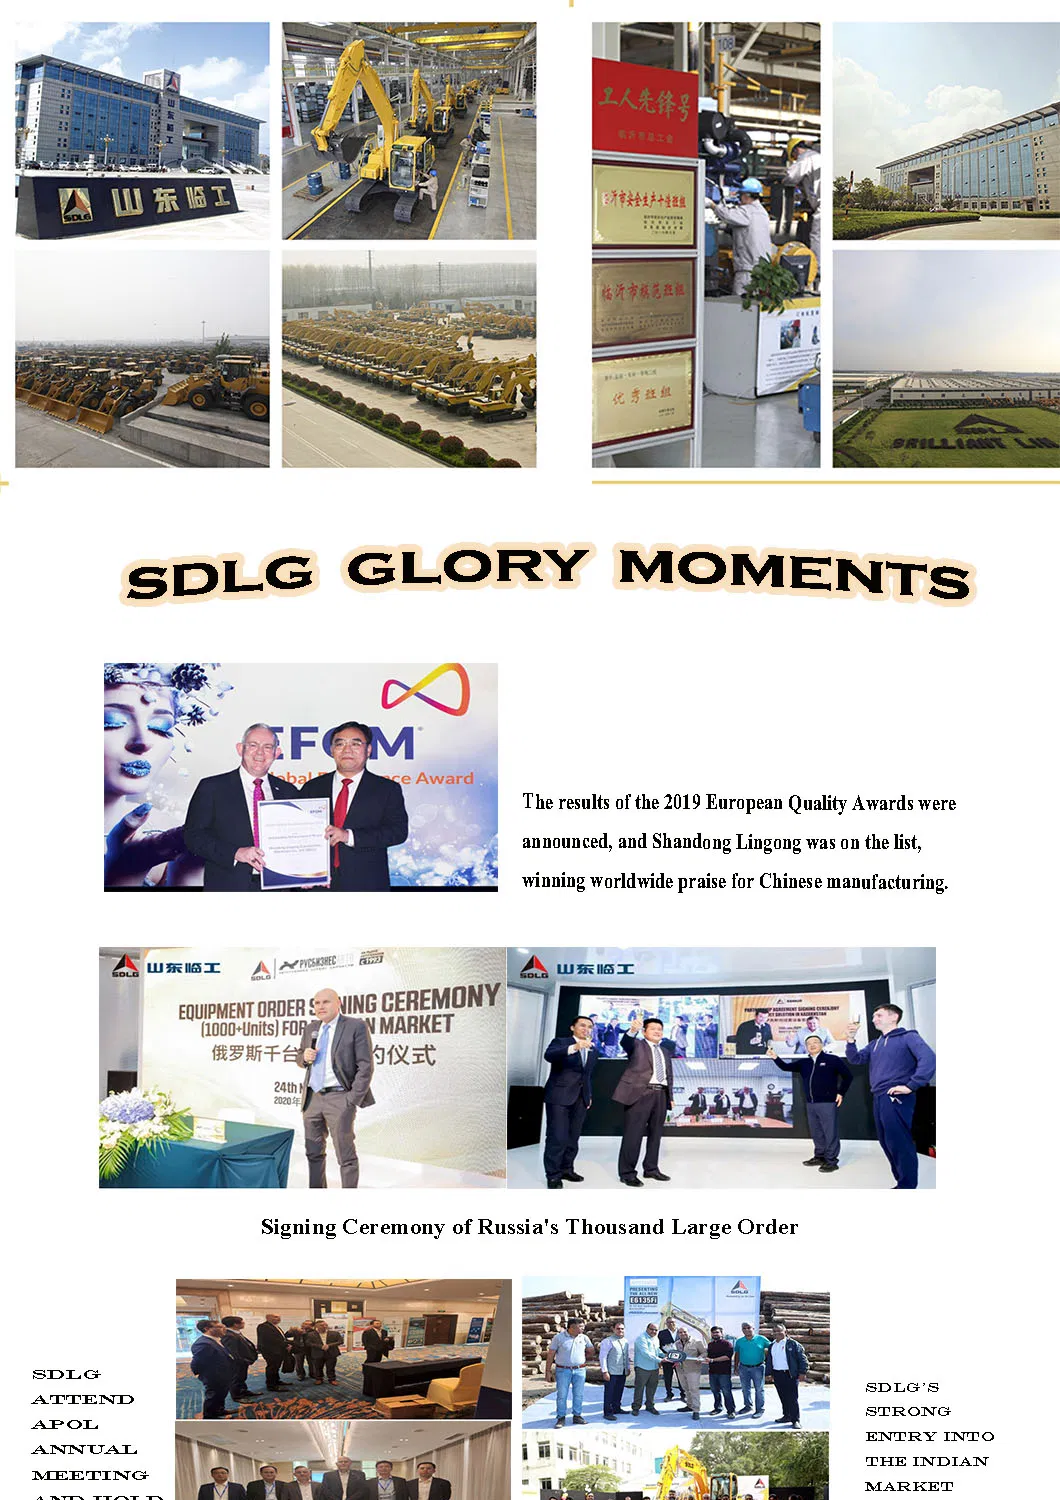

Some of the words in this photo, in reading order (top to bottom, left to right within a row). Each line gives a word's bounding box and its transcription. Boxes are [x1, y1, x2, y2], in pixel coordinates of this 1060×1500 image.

[717, 36, 735, 50] 108
[598, 86, 691, 122] 工人先锋号
[111, 185, 230, 218] 山东临工
[63, 213, 92, 222] SDLG
[416, 772, 475, 786] Award
[178, 1001, 255, 1021] EQUIPMENT
[257, 999, 306, 1018] ORDER
[309, 993, 377, 1016] SNING
[382, 982, 502, 1013] CEREMONY
[201, 1020, 279, 1039] (1000+Units)
[379, 1013, 455, 1035] MARKET
